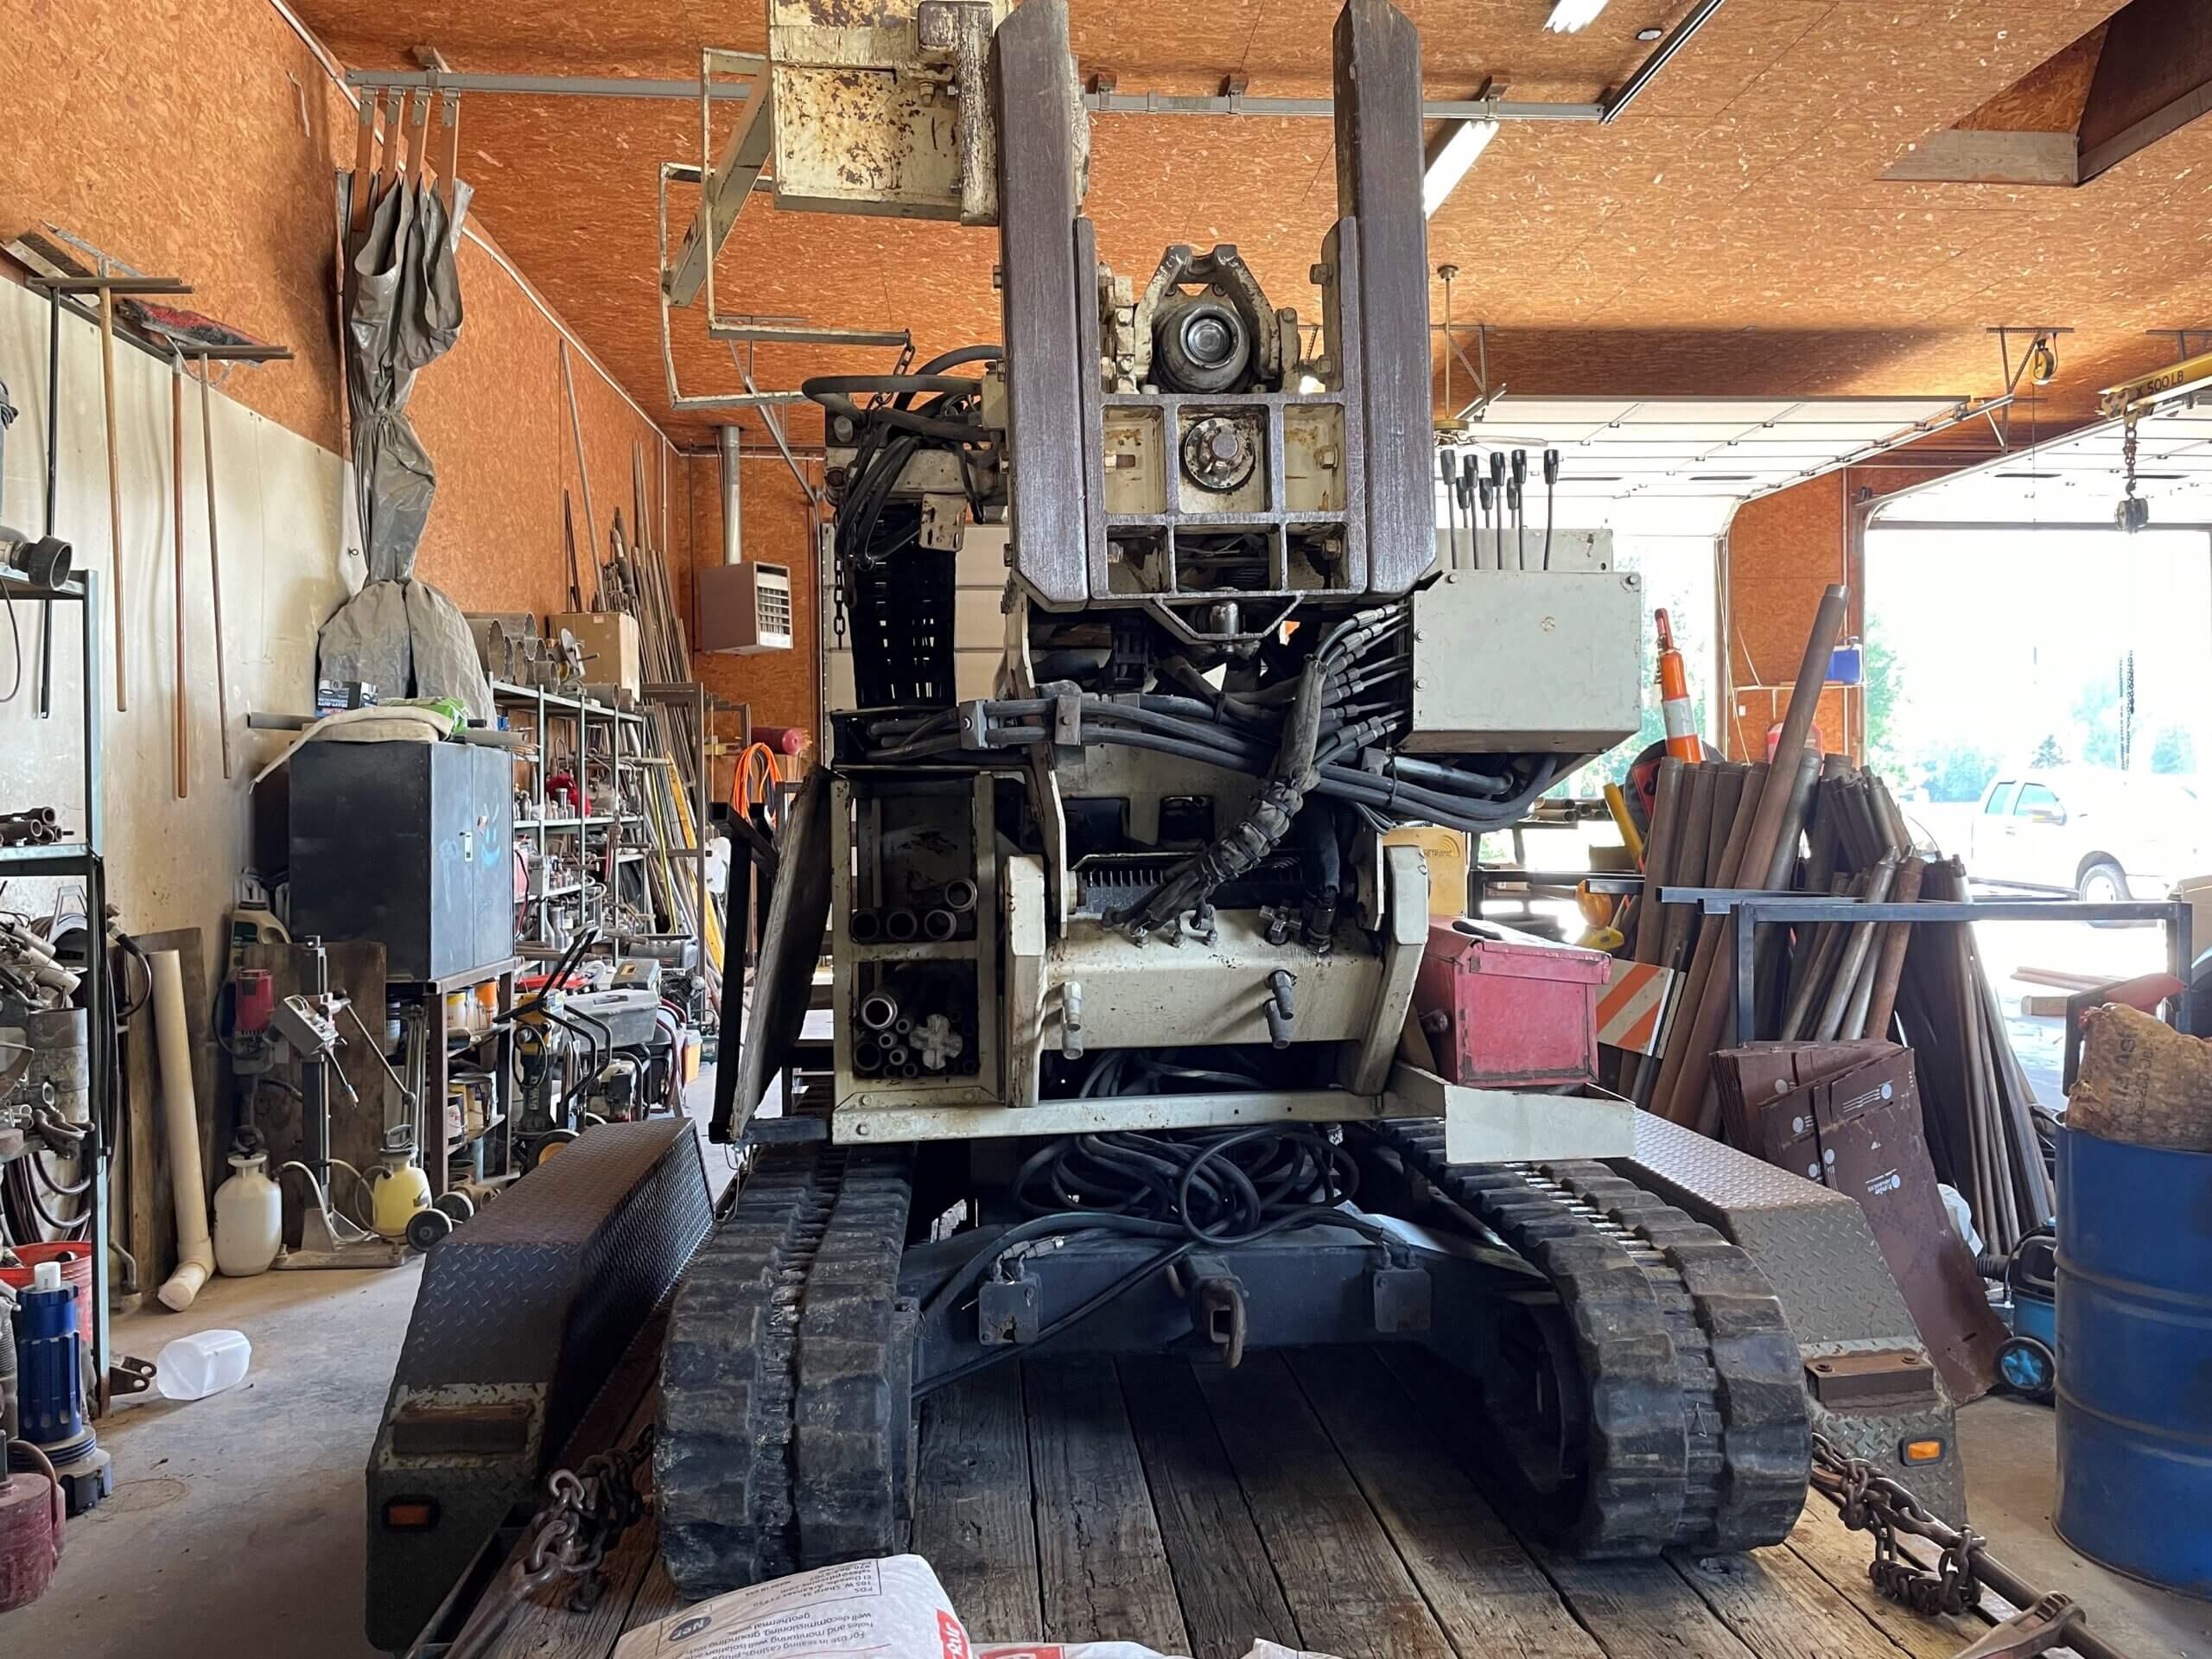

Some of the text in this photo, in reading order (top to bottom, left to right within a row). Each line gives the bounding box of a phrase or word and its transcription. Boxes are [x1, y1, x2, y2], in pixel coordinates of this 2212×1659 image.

[753, 1612, 810, 1630] geothermal
[851, 1612, 872, 1622] well
[672, 1619, 704, 1639] NSF
[827, 1624, 846, 1636] and
[849, 1630, 865, 1640] For
[708, 1630, 760, 1648] grounding
[770, 1629, 825, 1645] monitoring
[830, 1635, 848, 1643] use
[704, 1643, 747, 1656] isolation
[748, 1639, 768, 1648] well
[783, 1640, 817, 1650] sealing
